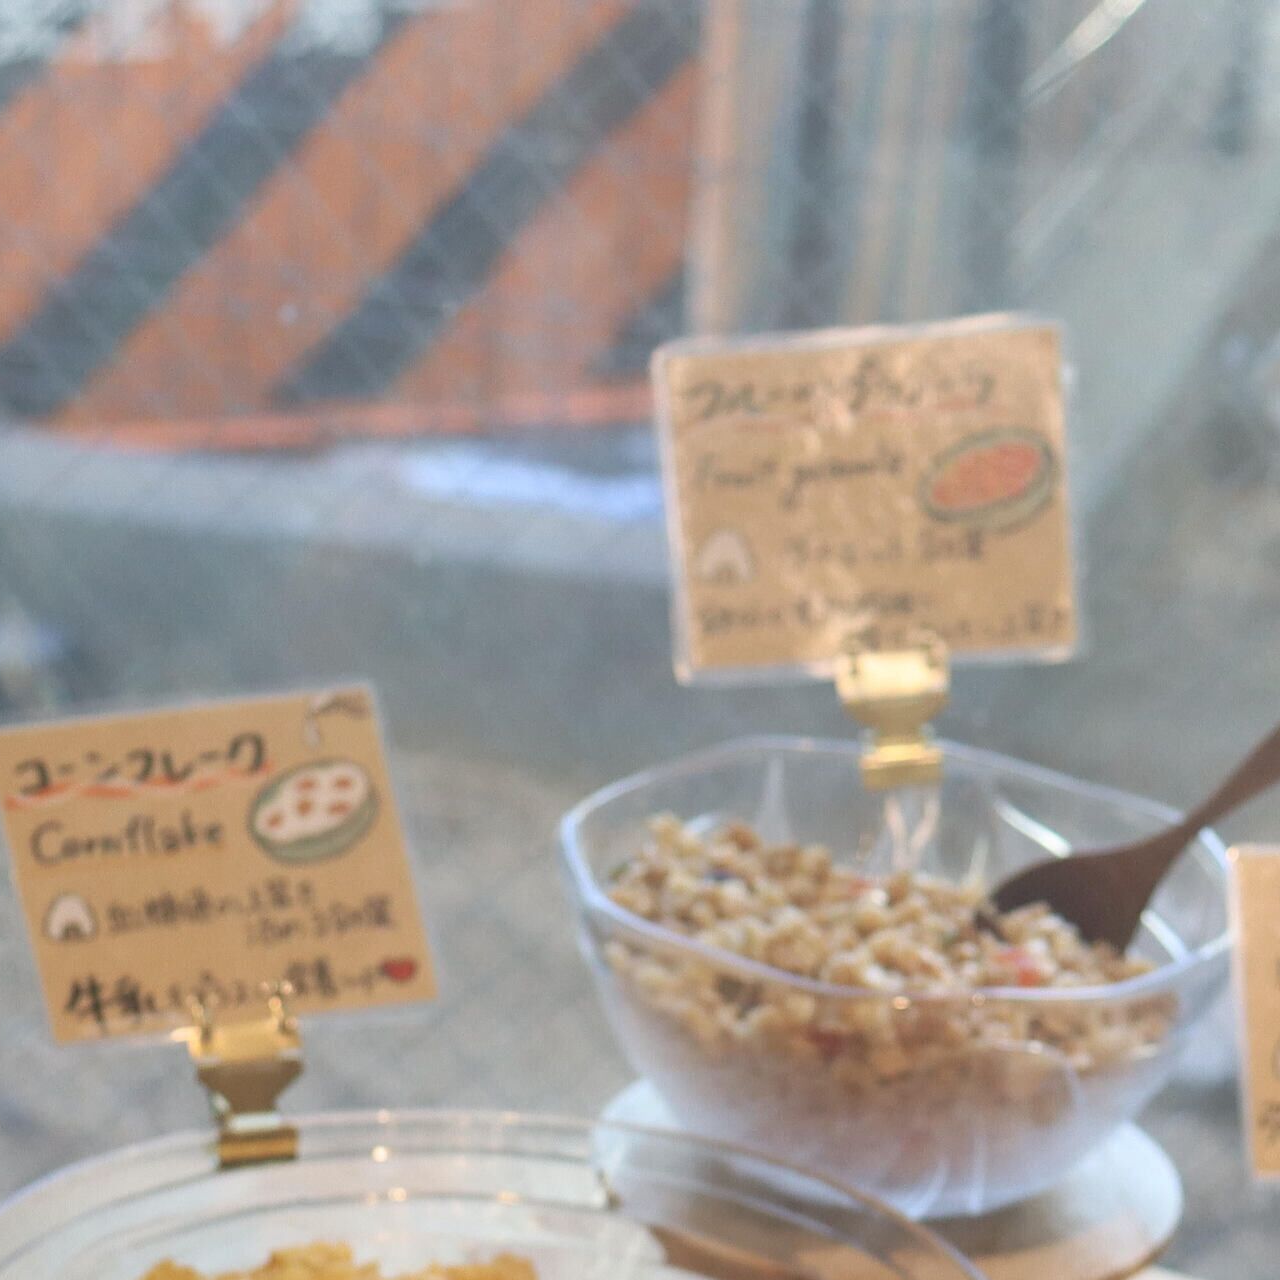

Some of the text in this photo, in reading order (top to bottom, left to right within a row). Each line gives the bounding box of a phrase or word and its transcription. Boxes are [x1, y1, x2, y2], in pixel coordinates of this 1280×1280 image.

[14, 732, 267, 796] コーンフレーク
[30, 807, 225, 866] Cornflake
